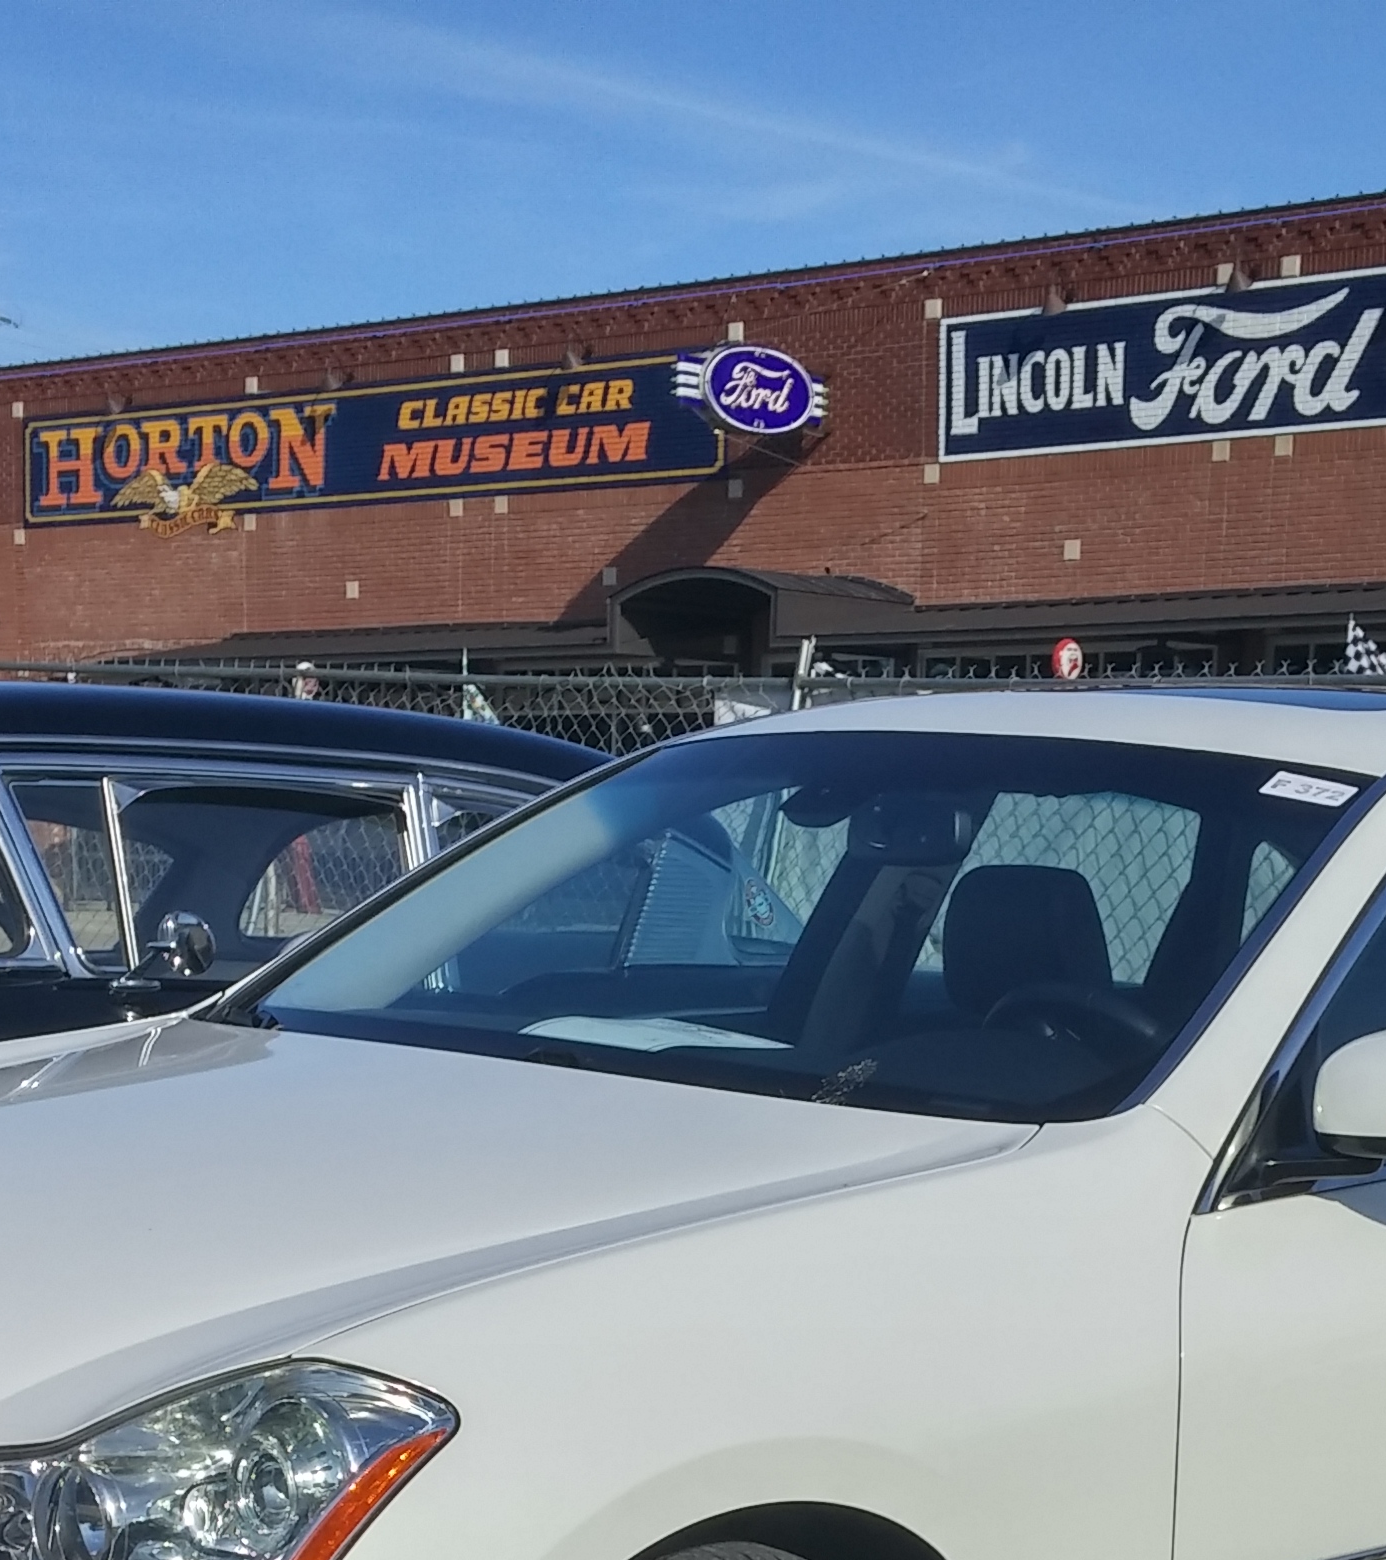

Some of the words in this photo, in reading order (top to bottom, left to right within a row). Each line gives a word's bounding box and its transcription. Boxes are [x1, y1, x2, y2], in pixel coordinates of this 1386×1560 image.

[719, 361, 795, 414] Ford
[949, 330, 1127, 436] LINCOLN
[1129, 286, 1384, 432] Ford
[397, 385, 548, 430] CLASSIC
[555, 378, 635, 416] CAR
[39, 402, 337, 507] HORTON
[376, 420, 652, 482] MUSEUM
[1270, 778, 1291, 790] F
[1294, 783, 1346, 802] 372
